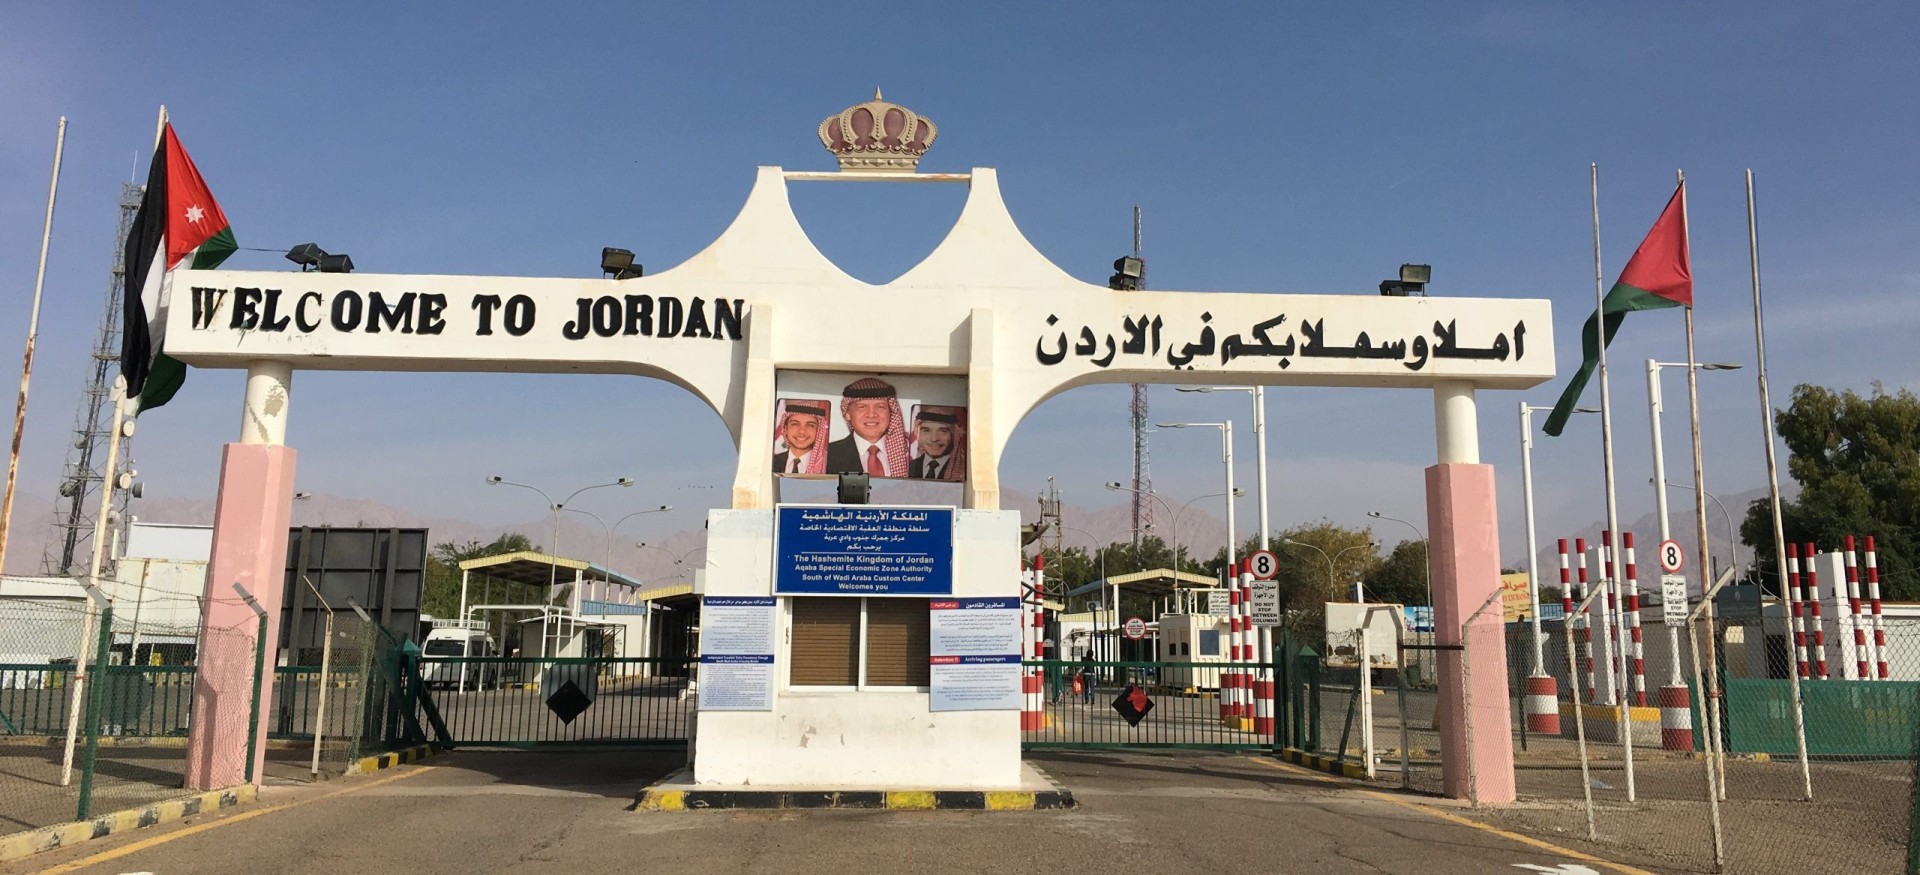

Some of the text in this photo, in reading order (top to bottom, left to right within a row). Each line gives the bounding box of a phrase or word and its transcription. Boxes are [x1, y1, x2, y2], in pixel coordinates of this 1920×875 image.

[190, 286, 744, 341] WELCOME TO JORDAN
[1036, 313, 1164, 367] الاردن
[1167, 311, 1216, 370] في
[1221, 313, 1298, 370] بكم
[802, 510, 853, 522] الهاشمية
[892, 512, 928, 521] المملكة
[823, 524, 858, 532] الاقتصادية
[883, 524, 907, 533] منطقة
[908, 525, 930, 533] سلطة
[839, 534, 852, 543] وادي
[872, 534, 889, 542] جمرك
[890, 534, 905, 542] مركز
[846, 543, 882, 552] يرحب بكم
[811, 555, 855, 563] Hashemite
[856, 556, 893, 564] Kingdom
[895, 556, 905, 564] of
[905, 556, 934, 564] Jordan
[1667, 546, 1677, 566] 8
[795, 565, 817, 573] Aqaba
[1258, 556, 1270, 574] 8
[838, 583, 873, 591] Welcomes
